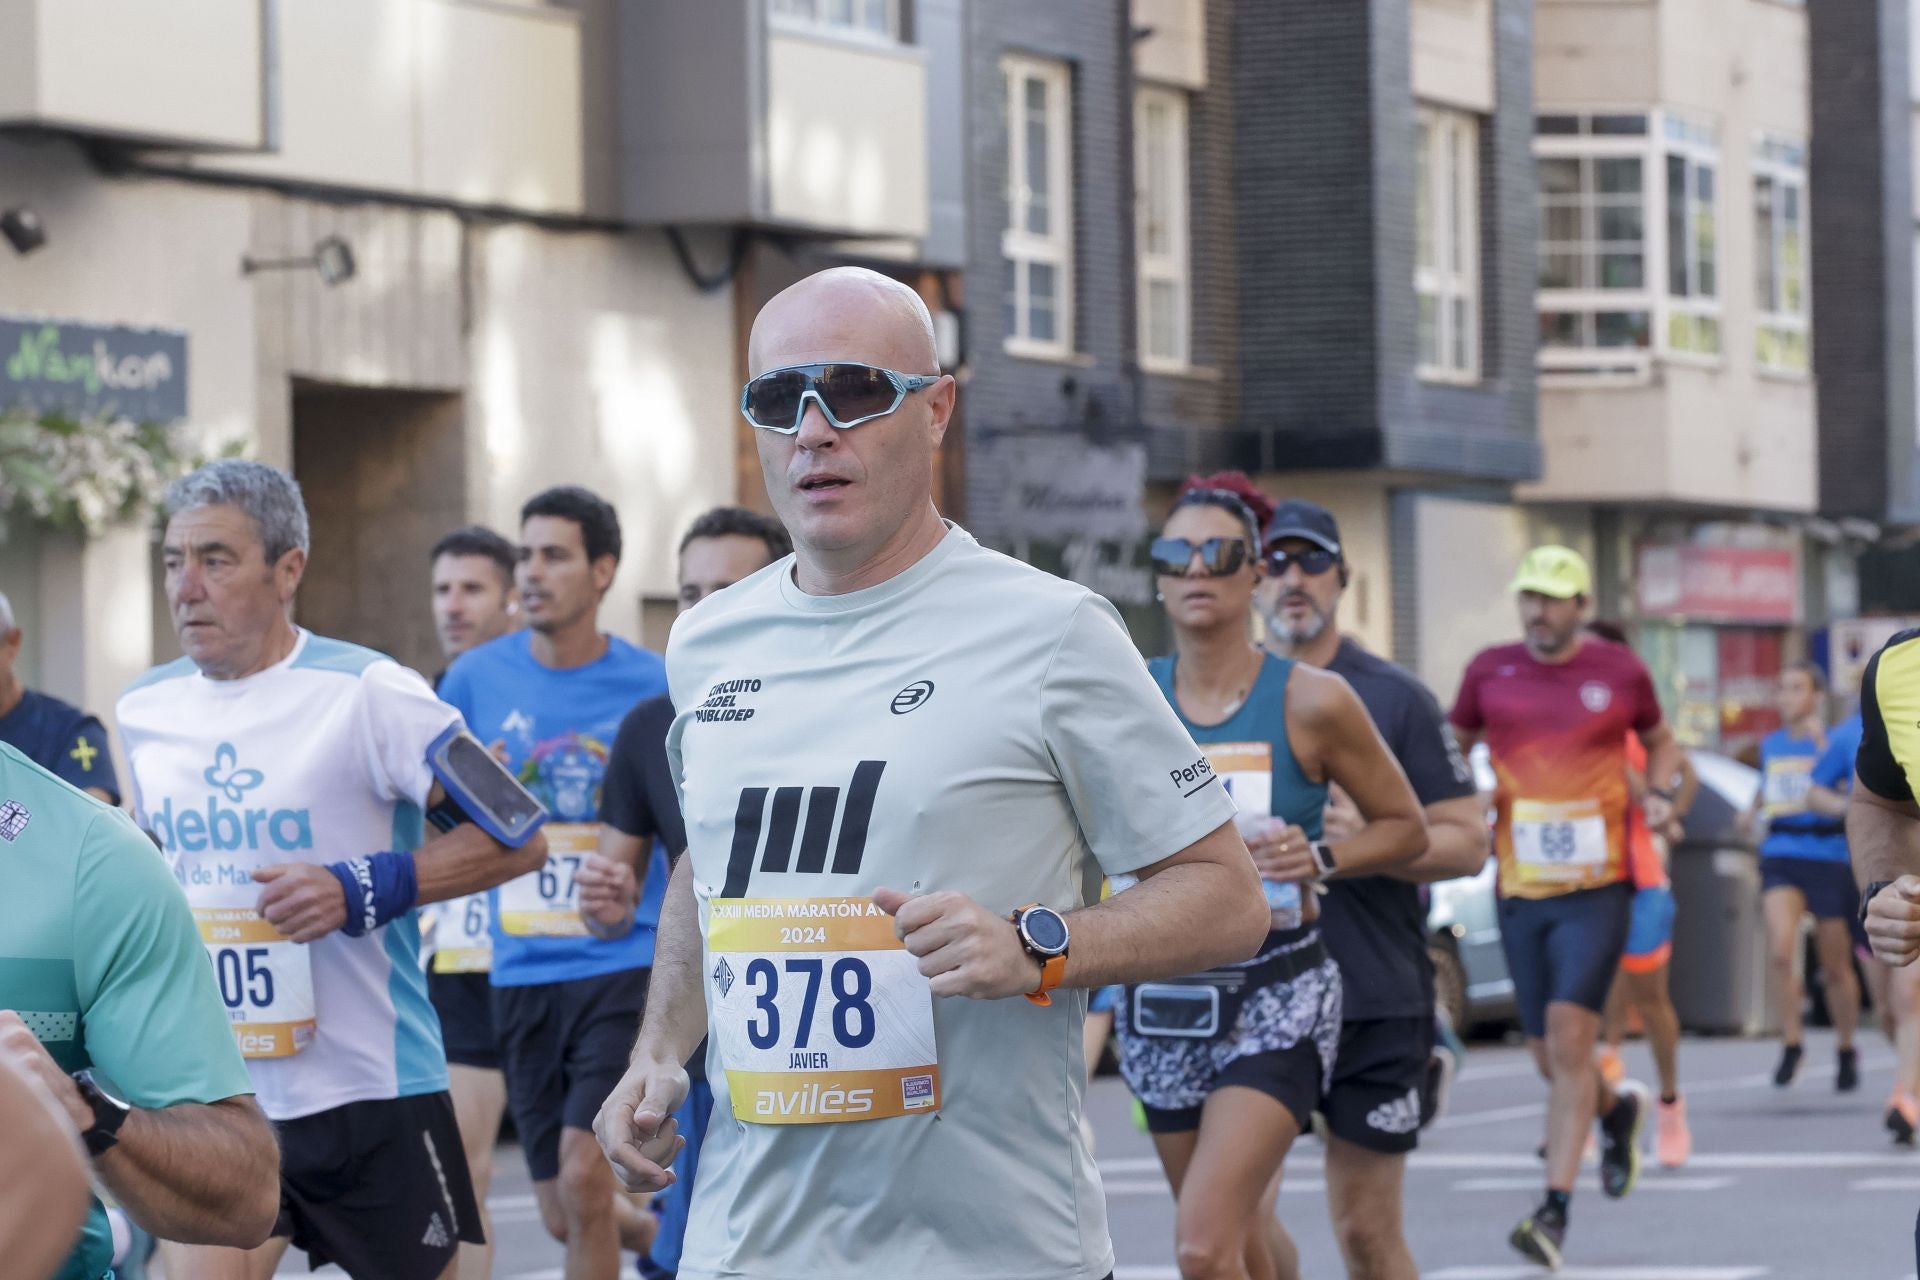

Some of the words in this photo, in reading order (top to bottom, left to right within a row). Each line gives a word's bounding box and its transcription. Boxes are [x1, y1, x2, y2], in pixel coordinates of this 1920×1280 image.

[708, 678, 762, 697] CIRCUITO
[695, 708, 755, 723] PUBLIDEP
[152, 796, 313, 852] debra
[191, 864, 212, 885] de
[745, 903, 784, 918] MEDIA
[787, 900, 862, 917] MARATÓN
[780, 927, 826, 944] 2024
[217, 948, 274, 1008] 05
[746, 957, 876, 1050] 378
[788, 1052, 829, 1069] JAVIER
[755, 1083, 874, 1116] avilés
